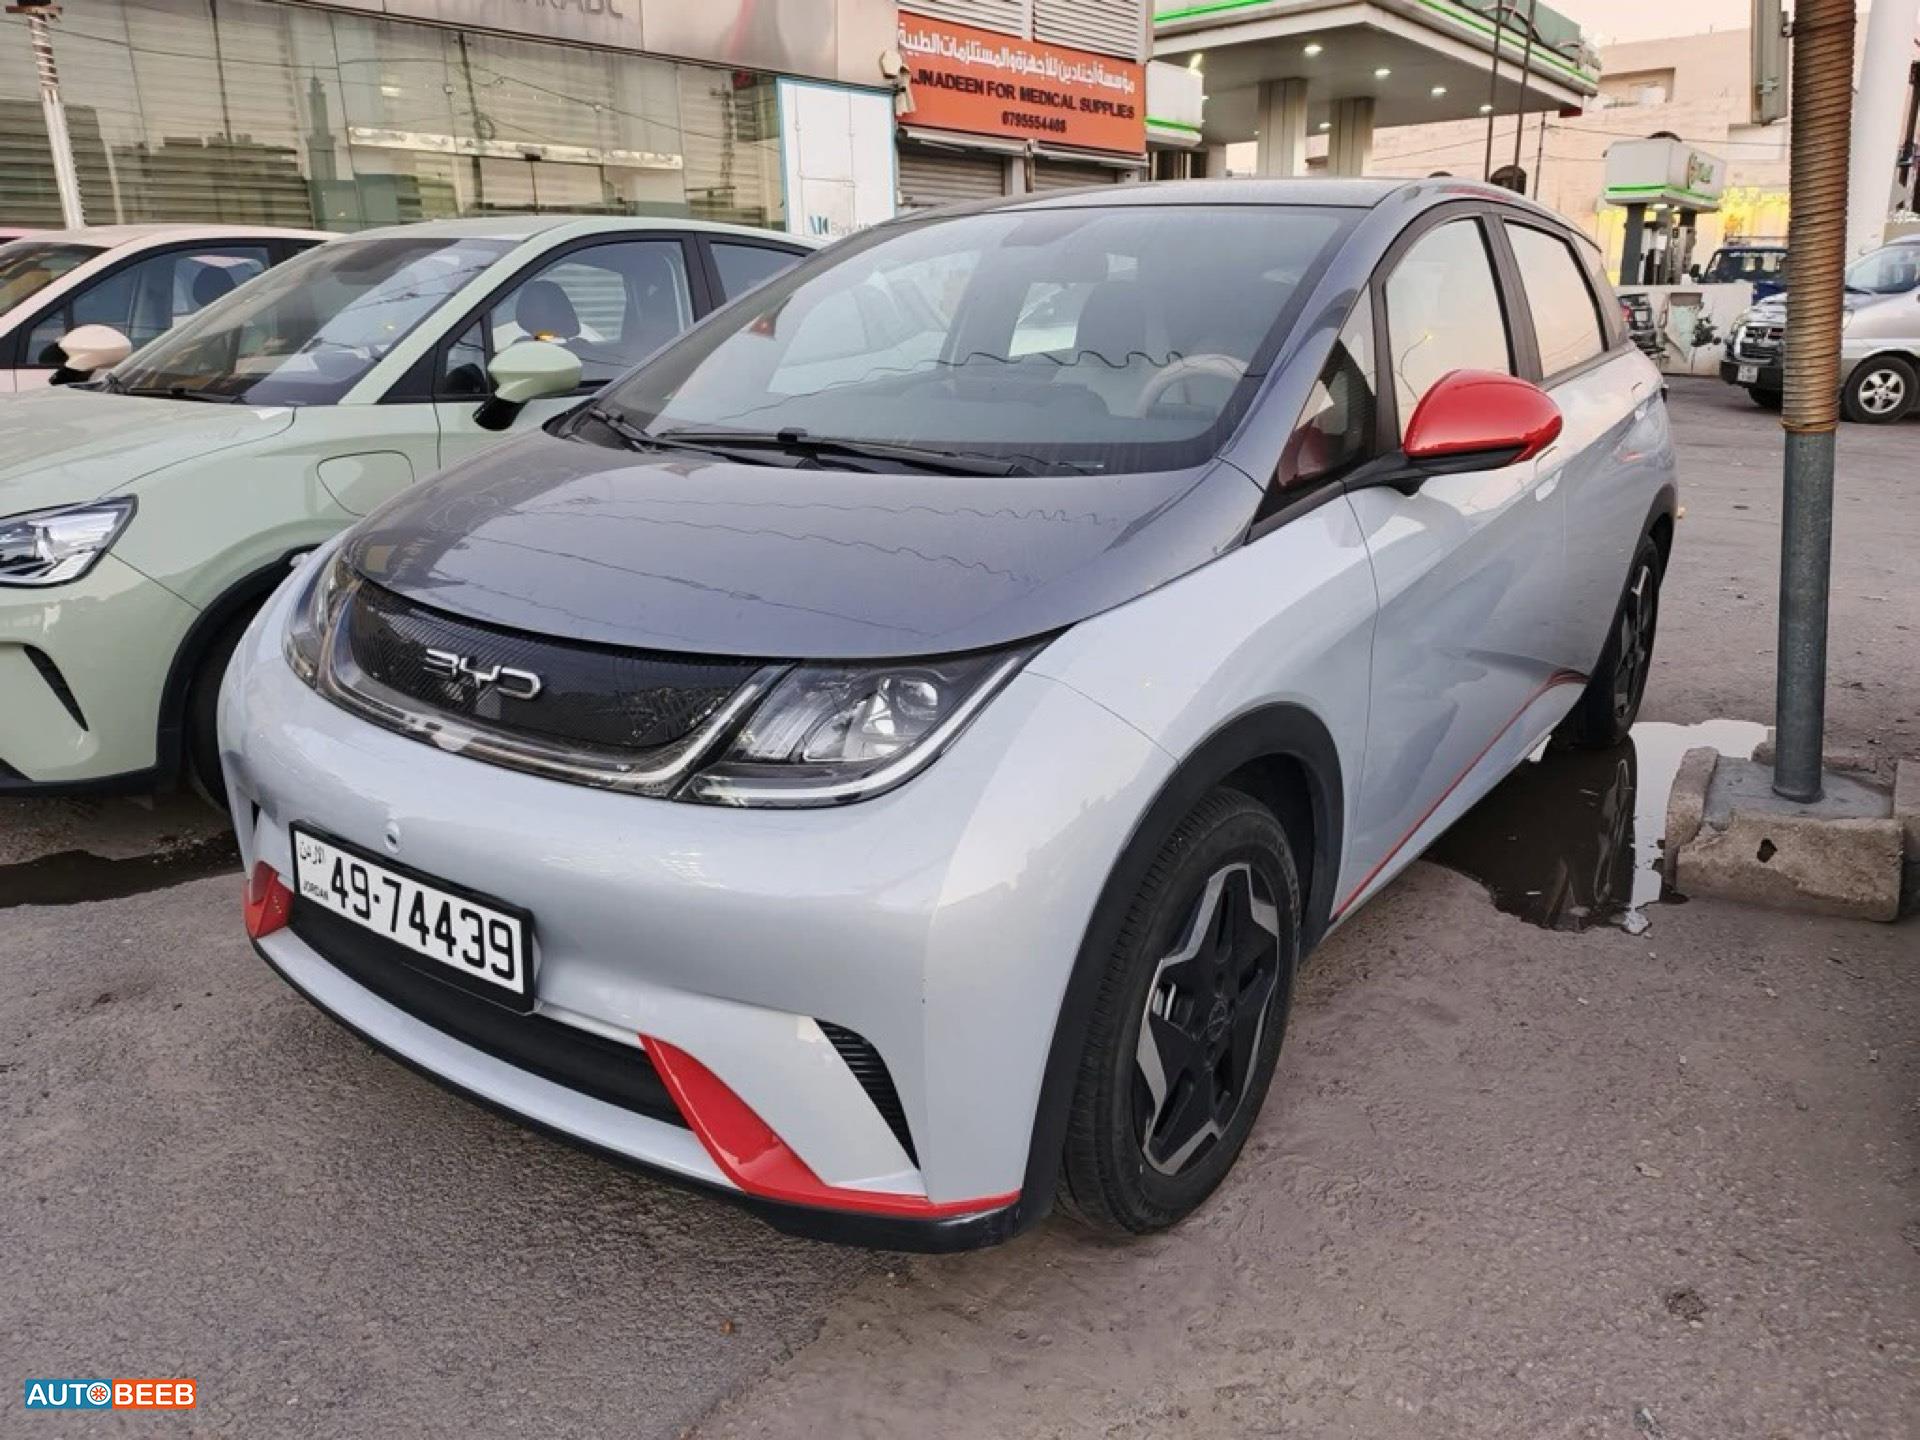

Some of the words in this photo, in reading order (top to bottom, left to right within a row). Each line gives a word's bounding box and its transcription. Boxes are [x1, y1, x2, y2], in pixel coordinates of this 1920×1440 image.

[898, 22, 941, 57] الطبية
[1098, 63, 1135, 95] مؤسسة
[987, 80, 1016, 99] FOR
[1020, 86, 1076, 110] MEDICAL
[1080, 97, 1135, 118] SUPPLIES
[423, 648, 541, 699] BYD
[303, 880, 329, 901] JORDAN
